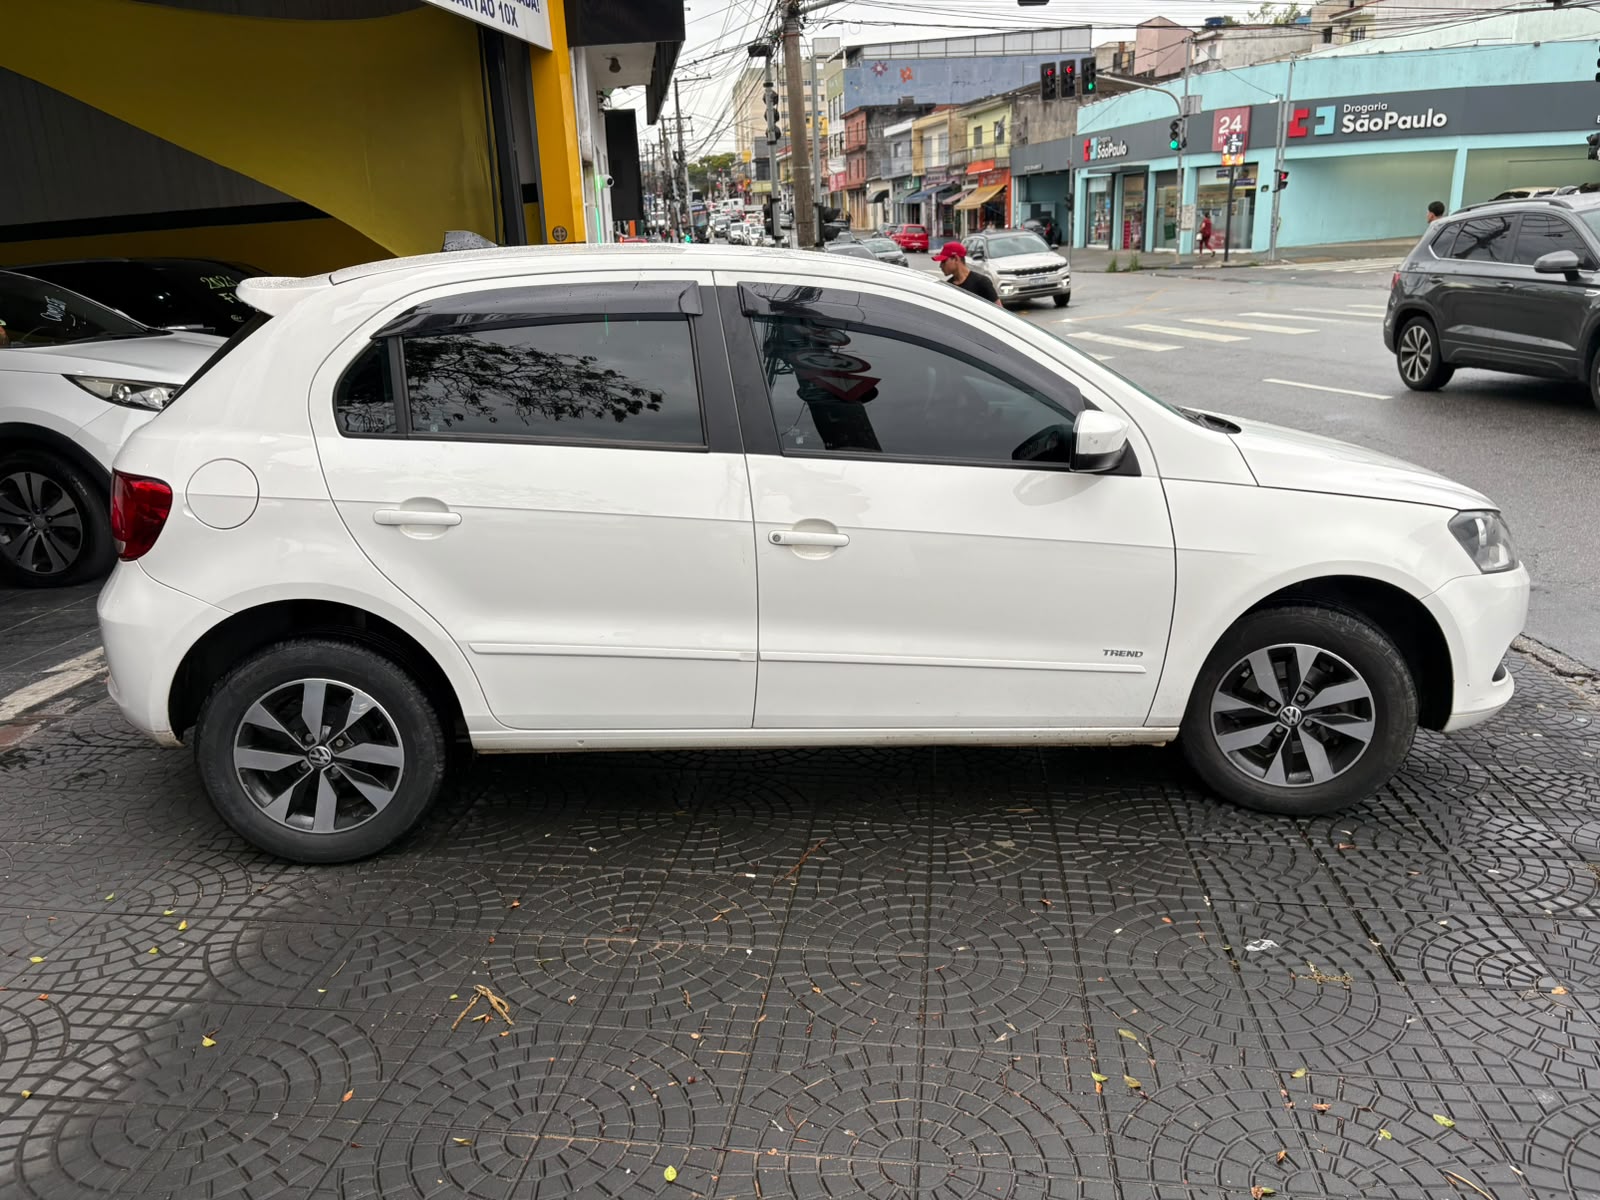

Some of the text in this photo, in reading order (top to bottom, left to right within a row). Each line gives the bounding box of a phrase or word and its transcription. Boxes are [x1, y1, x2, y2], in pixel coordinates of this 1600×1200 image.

[498, 2, 519, 28] 10X
[1343, 102, 1388, 114] Drogaria
[1218, 114, 1242, 134] 24
[1341, 108, 1448, 133] SãoPaulo
[1102, 648, 1144, 658] TREND
